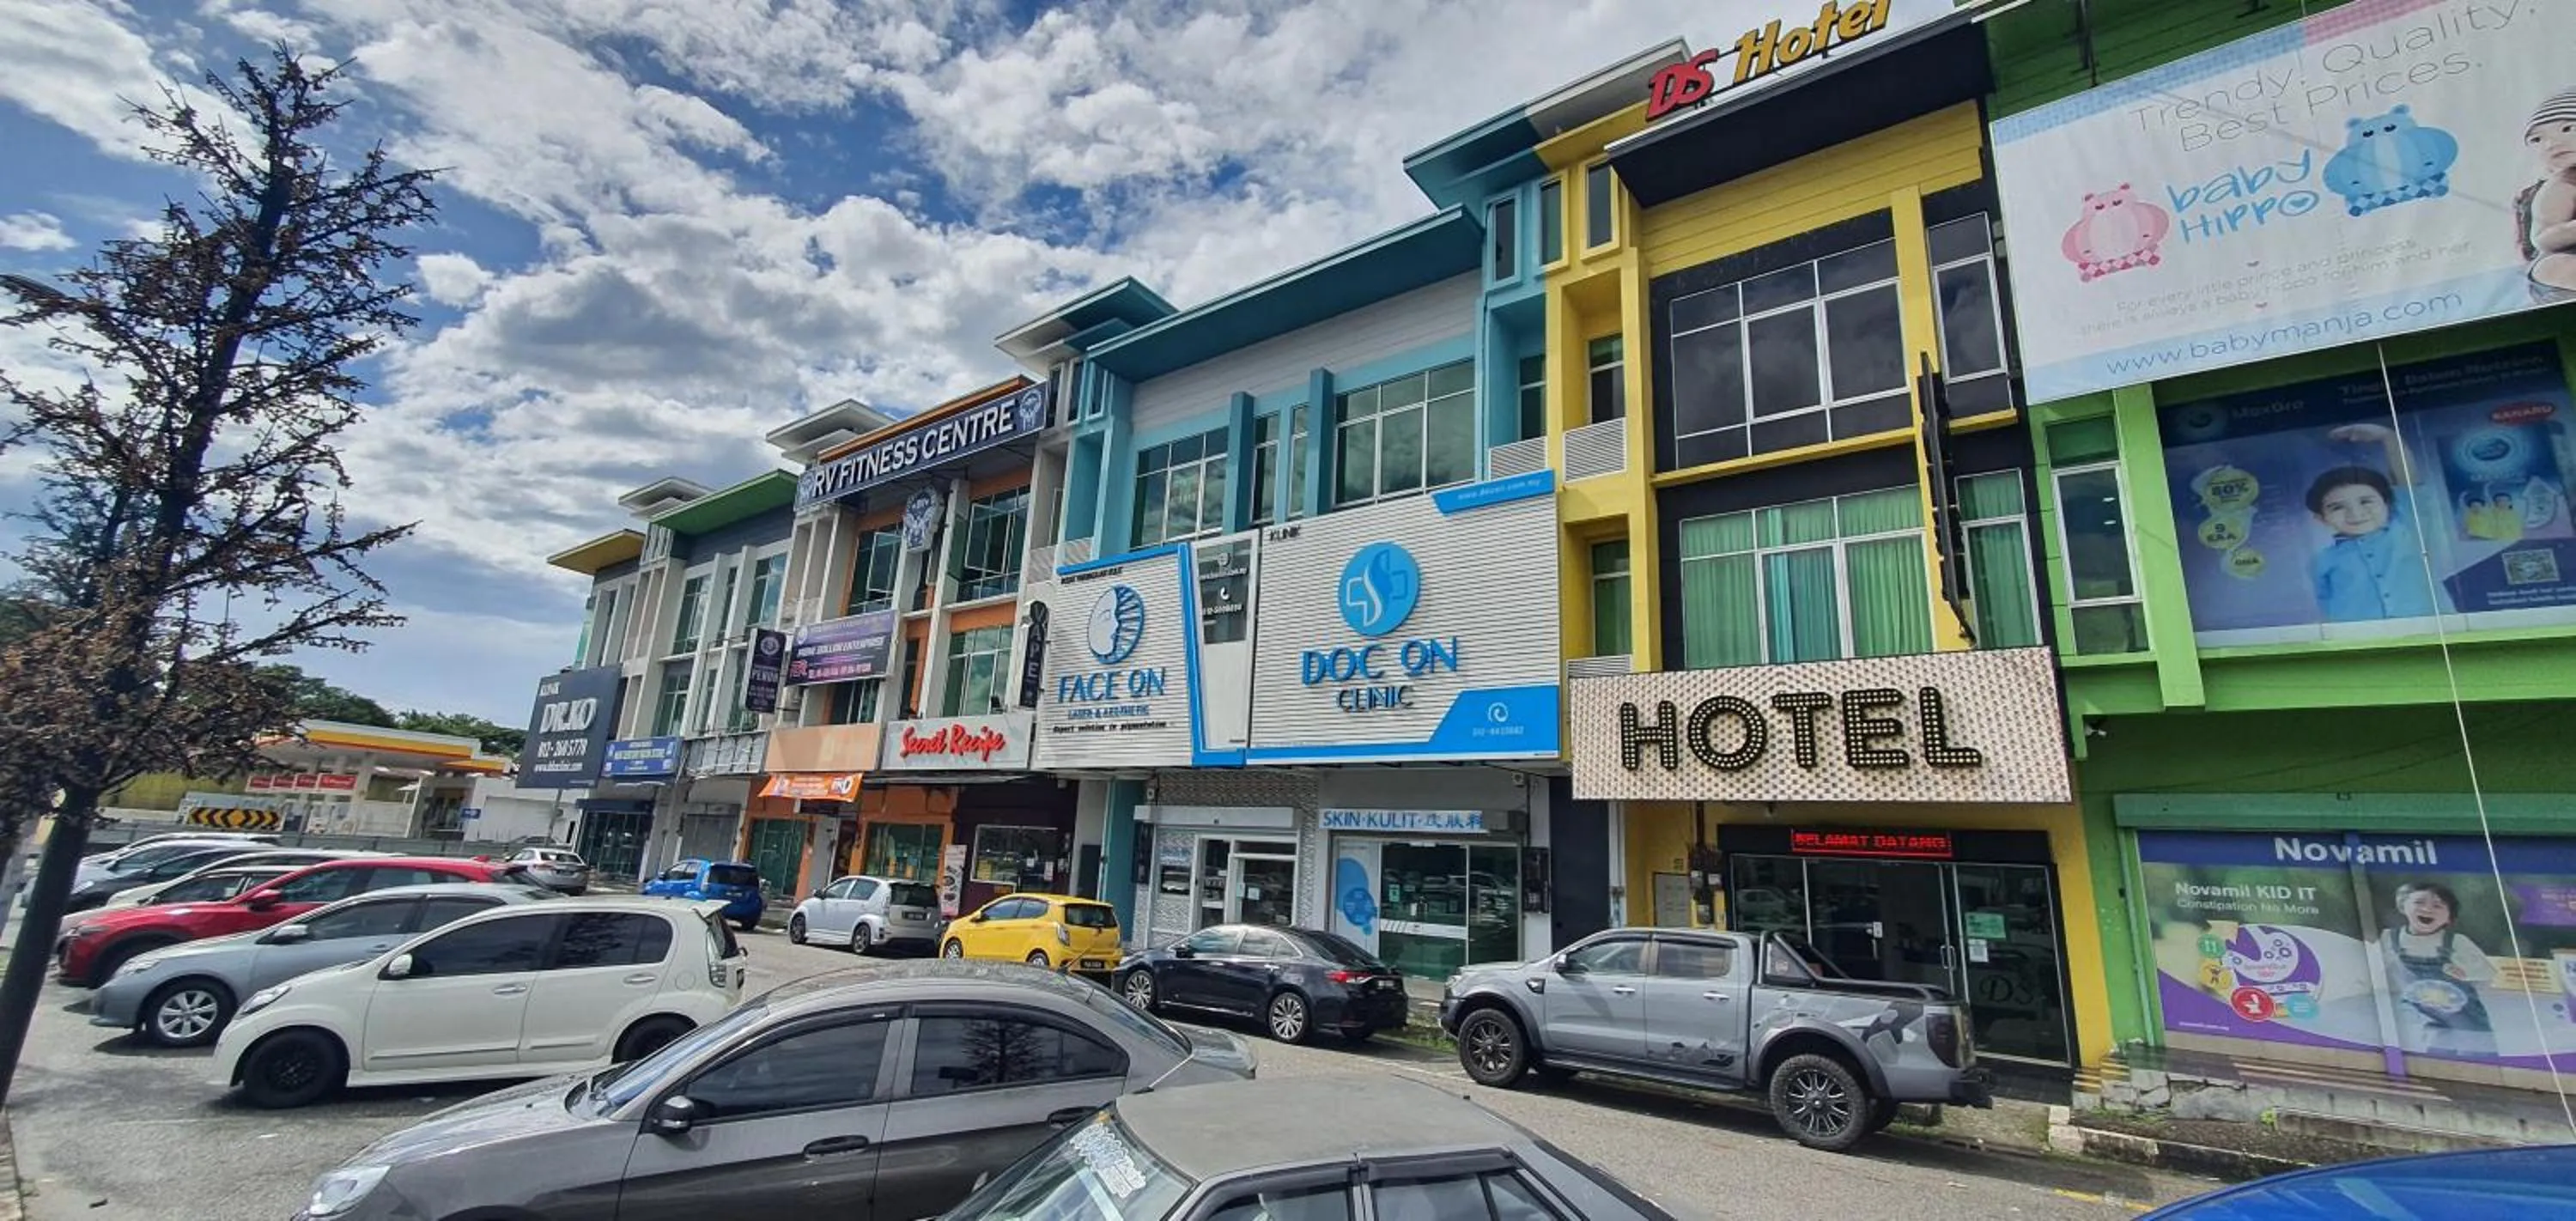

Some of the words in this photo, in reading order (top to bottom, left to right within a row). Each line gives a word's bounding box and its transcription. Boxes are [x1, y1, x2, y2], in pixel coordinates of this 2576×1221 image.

[1733, 0, 1892, 85] Hotel
[2178, 100, 2290, 152] Best
[2166, 149, 2311, 213] baby
[2106, 290, 2464, 376] www.babymanja.com
[812, 464, 840, 497] RV
[839, 439, 919, 489] FITNESS
[920, 398, 1018, 459] CENTRE
[1057, 671, 1122, 703] FACE
[1127, 667, 1166, 697] ON
[1300, 643, 1386, 686] DOC
[1400, 635, 1458, 677] ON
[1338, 685, 1415, 713] CLINIC
[900, 726, 948, 758] Secret
[950, 724, 1006, 762] Recipe
[1619, 686, 1983, 771] HOTEL
[2275, 836, 2439, 866] Novamil
[2175, 882, 2251, 898] Novamil
[2257, 886, 2292, 900] KID
[2297, 887, 2317, 901] IT
